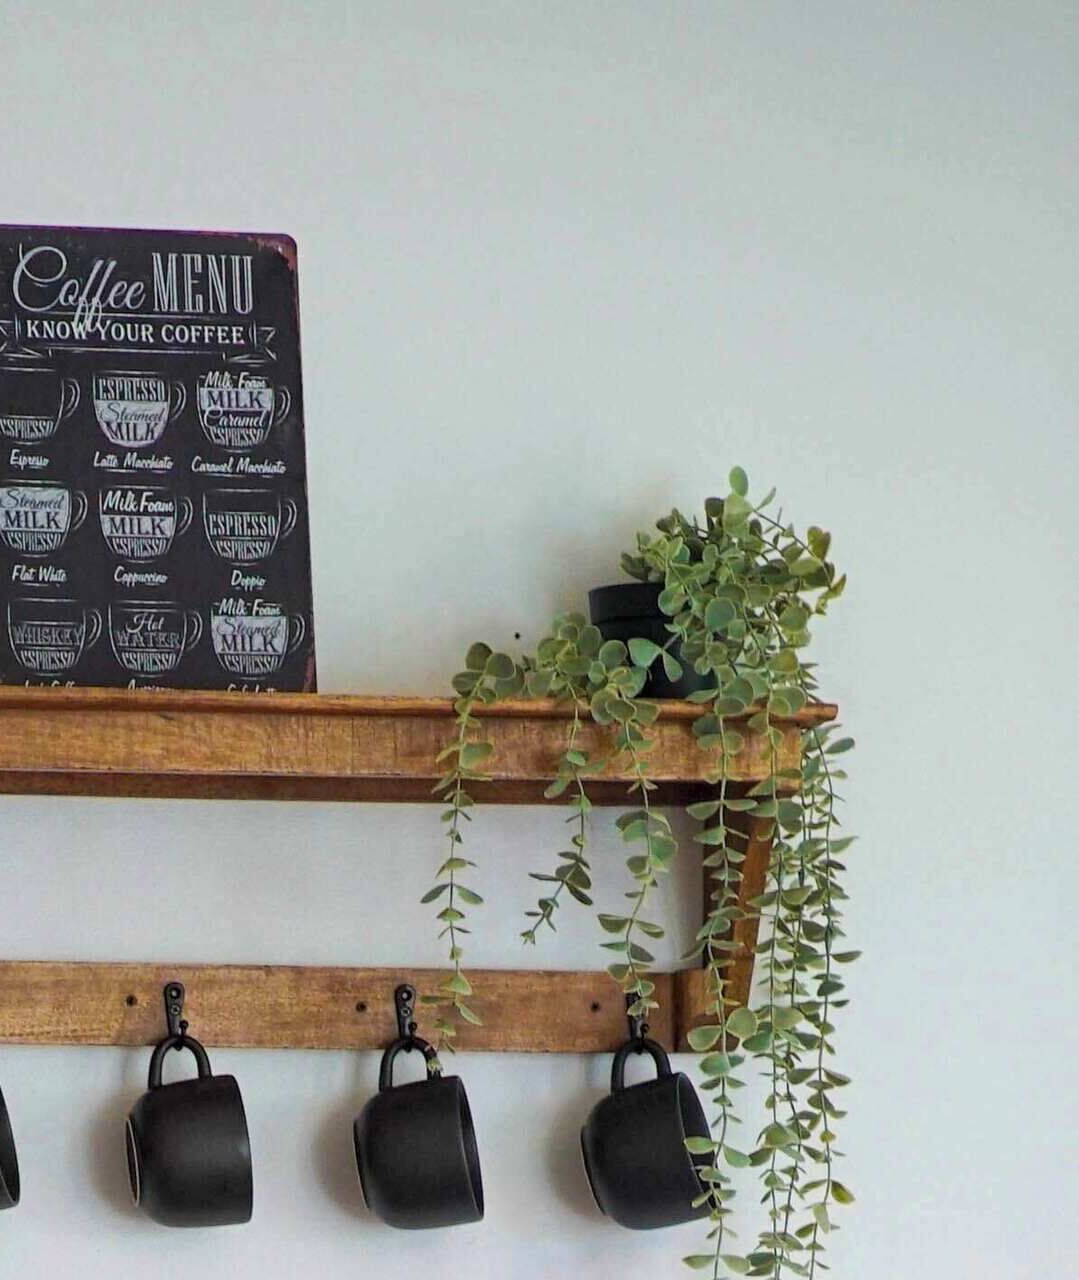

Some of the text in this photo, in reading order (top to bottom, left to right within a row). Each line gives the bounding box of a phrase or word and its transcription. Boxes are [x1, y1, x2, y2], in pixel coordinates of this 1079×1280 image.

[13, 243, 253, 332] Coffee MENU
[26, 320, 245, 344] KNOW YOUR COFFEE
[99, 378, 165, 400] ESPRESSO
[207, 391, 264, 408] MILK
[0, 418, 56, 440] ESPRESSO
[104, 422, 159, 440] MILK
[103, 490, 174, 512] Milk Foam
[5, 510, 61, 528] MILK
[110, 517, 166, 535] MILK
[209, 514, 276, 536] ESPRESSO
[216, 540, 271, 559] ESPRESSO
[12, 565, 67, 581] Flat White
[231, 570, 266, 592] Doppio
[13, 625, 83, 645] WHISKEY
[116, 631, 180, 648] WATER
[221, 635, 279, 652] MILK
[20, 650, 75, 670] ESPRESSO
[121, 652, 176, 672] ESPRESSO
